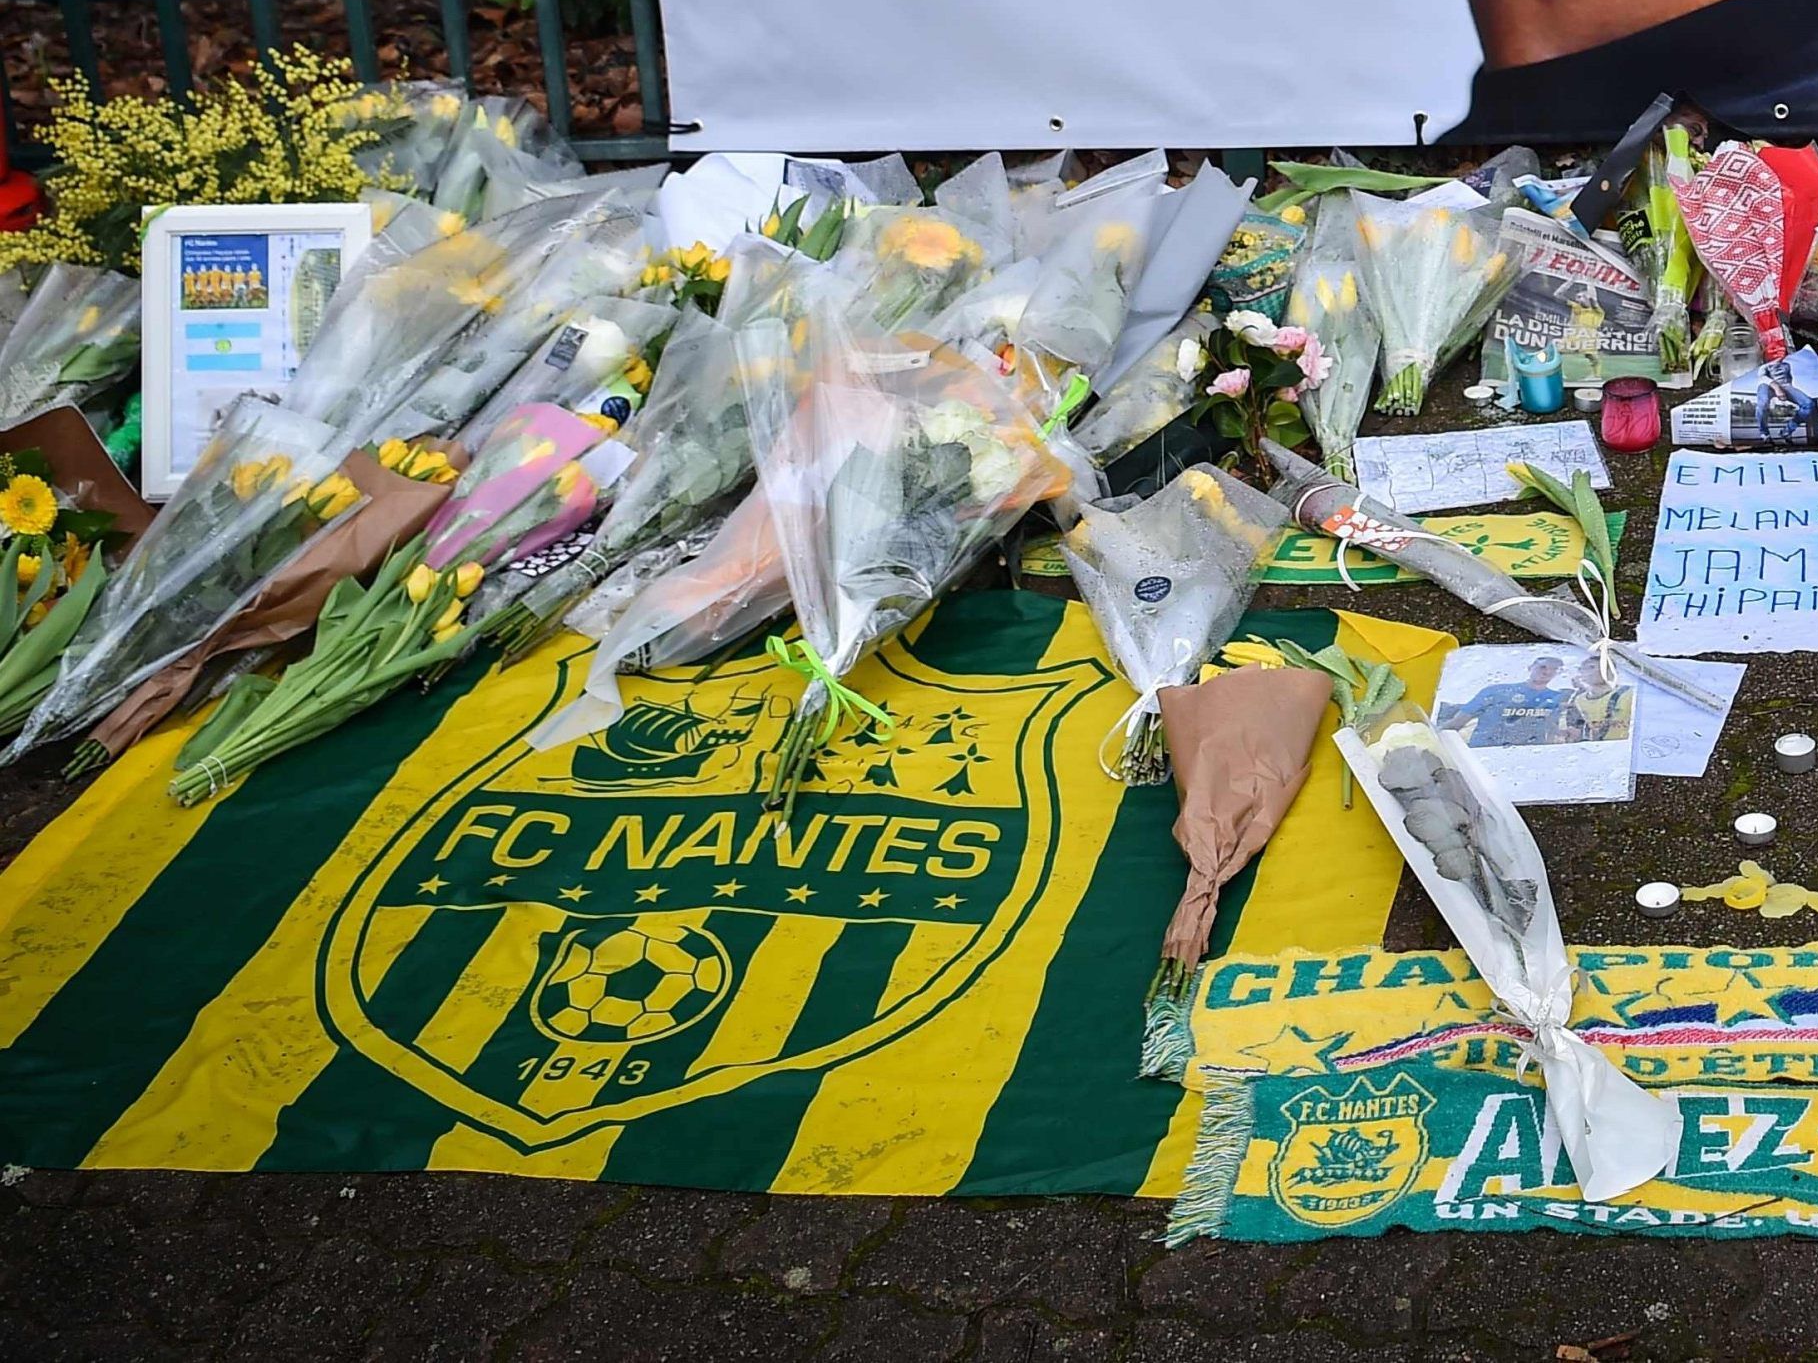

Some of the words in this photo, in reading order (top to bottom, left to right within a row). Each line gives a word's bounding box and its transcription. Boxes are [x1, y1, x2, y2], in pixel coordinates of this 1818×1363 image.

[1495, 309, 1524, 328] LA
[434, 804, 572, 869] FC
[584, 811, 1001, 879] NANTES
[515, 1056, 648, 1087] 1943
[1338, 1093, 1421, 1120] NANTES
[1433, 1092, 1815, 1205] AEZ
[1435, 1201, 1522, 1220] UN
